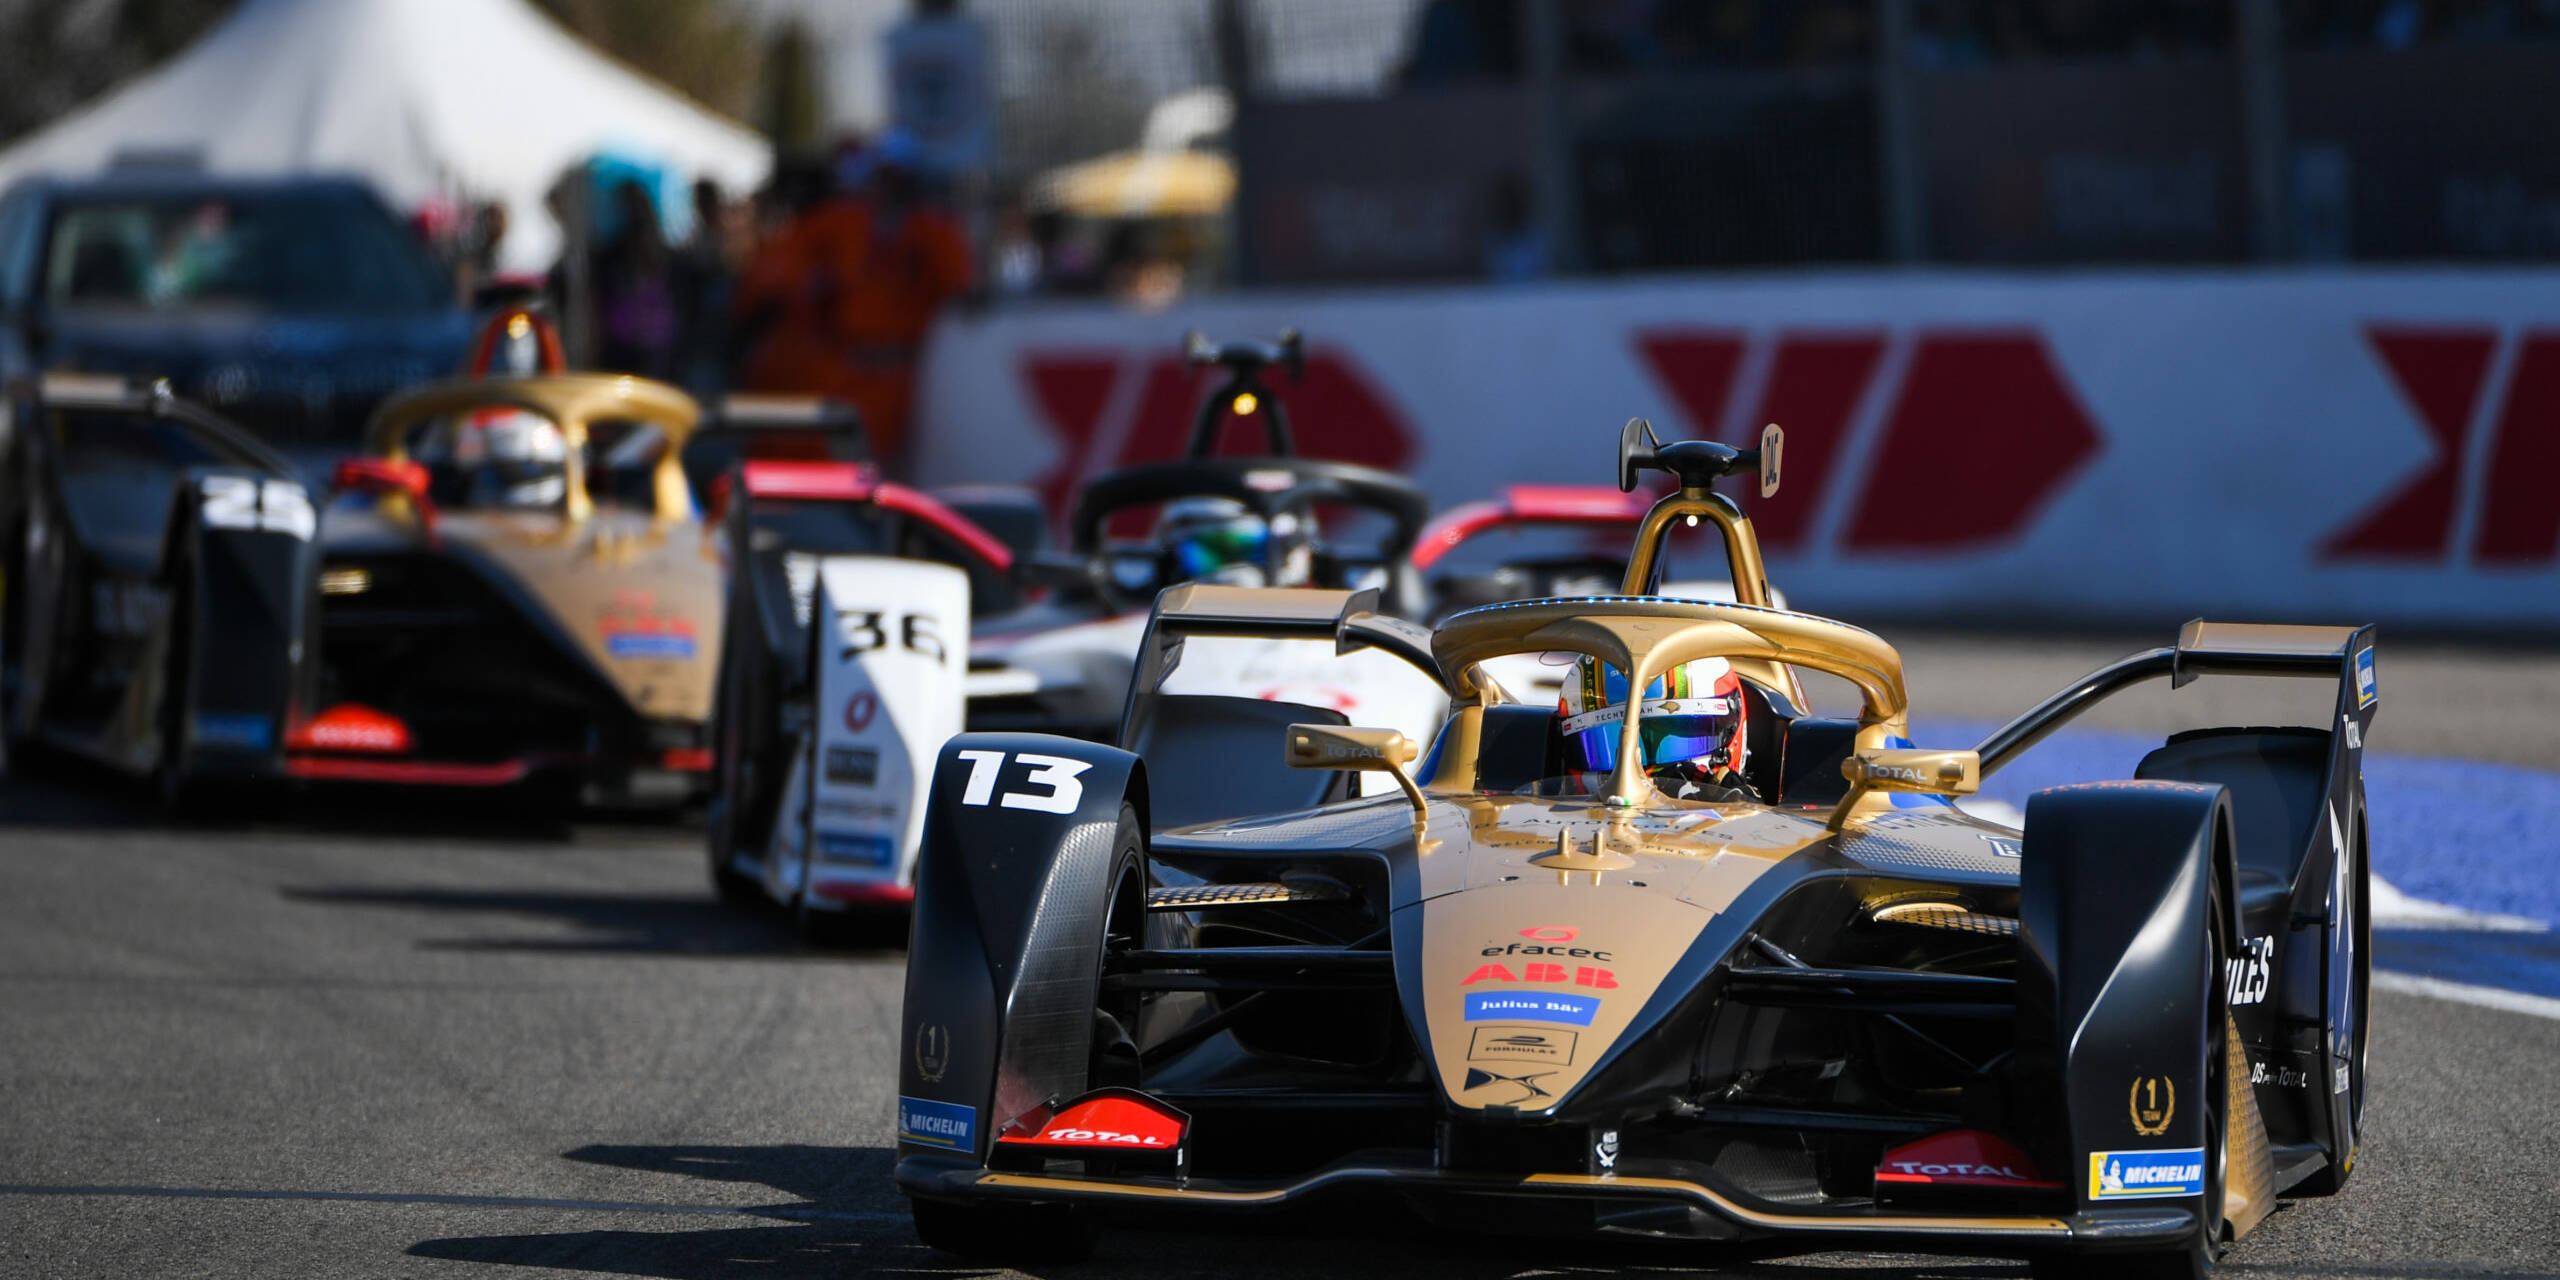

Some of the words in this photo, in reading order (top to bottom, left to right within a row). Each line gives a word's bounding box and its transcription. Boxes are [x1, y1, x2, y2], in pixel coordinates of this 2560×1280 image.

[202, 475, 316, 542] 25
[836, 609, 947, 667] 36
[1325, 743, 1385, 759] TOTAL
[958, 750, 1093, 815] 13
[1864, 763, 1929, 781] TOTAL
[1481, 943, 1613, 962] efacec
[1459, 962, 1619, 989] ABB
[2251, 1062, 2266, 1084] DS
[2279, 1066, 2307, 1089] TOTAL
[2146, 1078, 2157, 1109] 1
[911, 1113, 968, 1137] MICHELIN
[1048, 1128, 1165, 1145] TOTAL
[1892, 1162, 2028, 1180] TOTAL
[2124, 1164, 2202, 1184] MICHELIN
